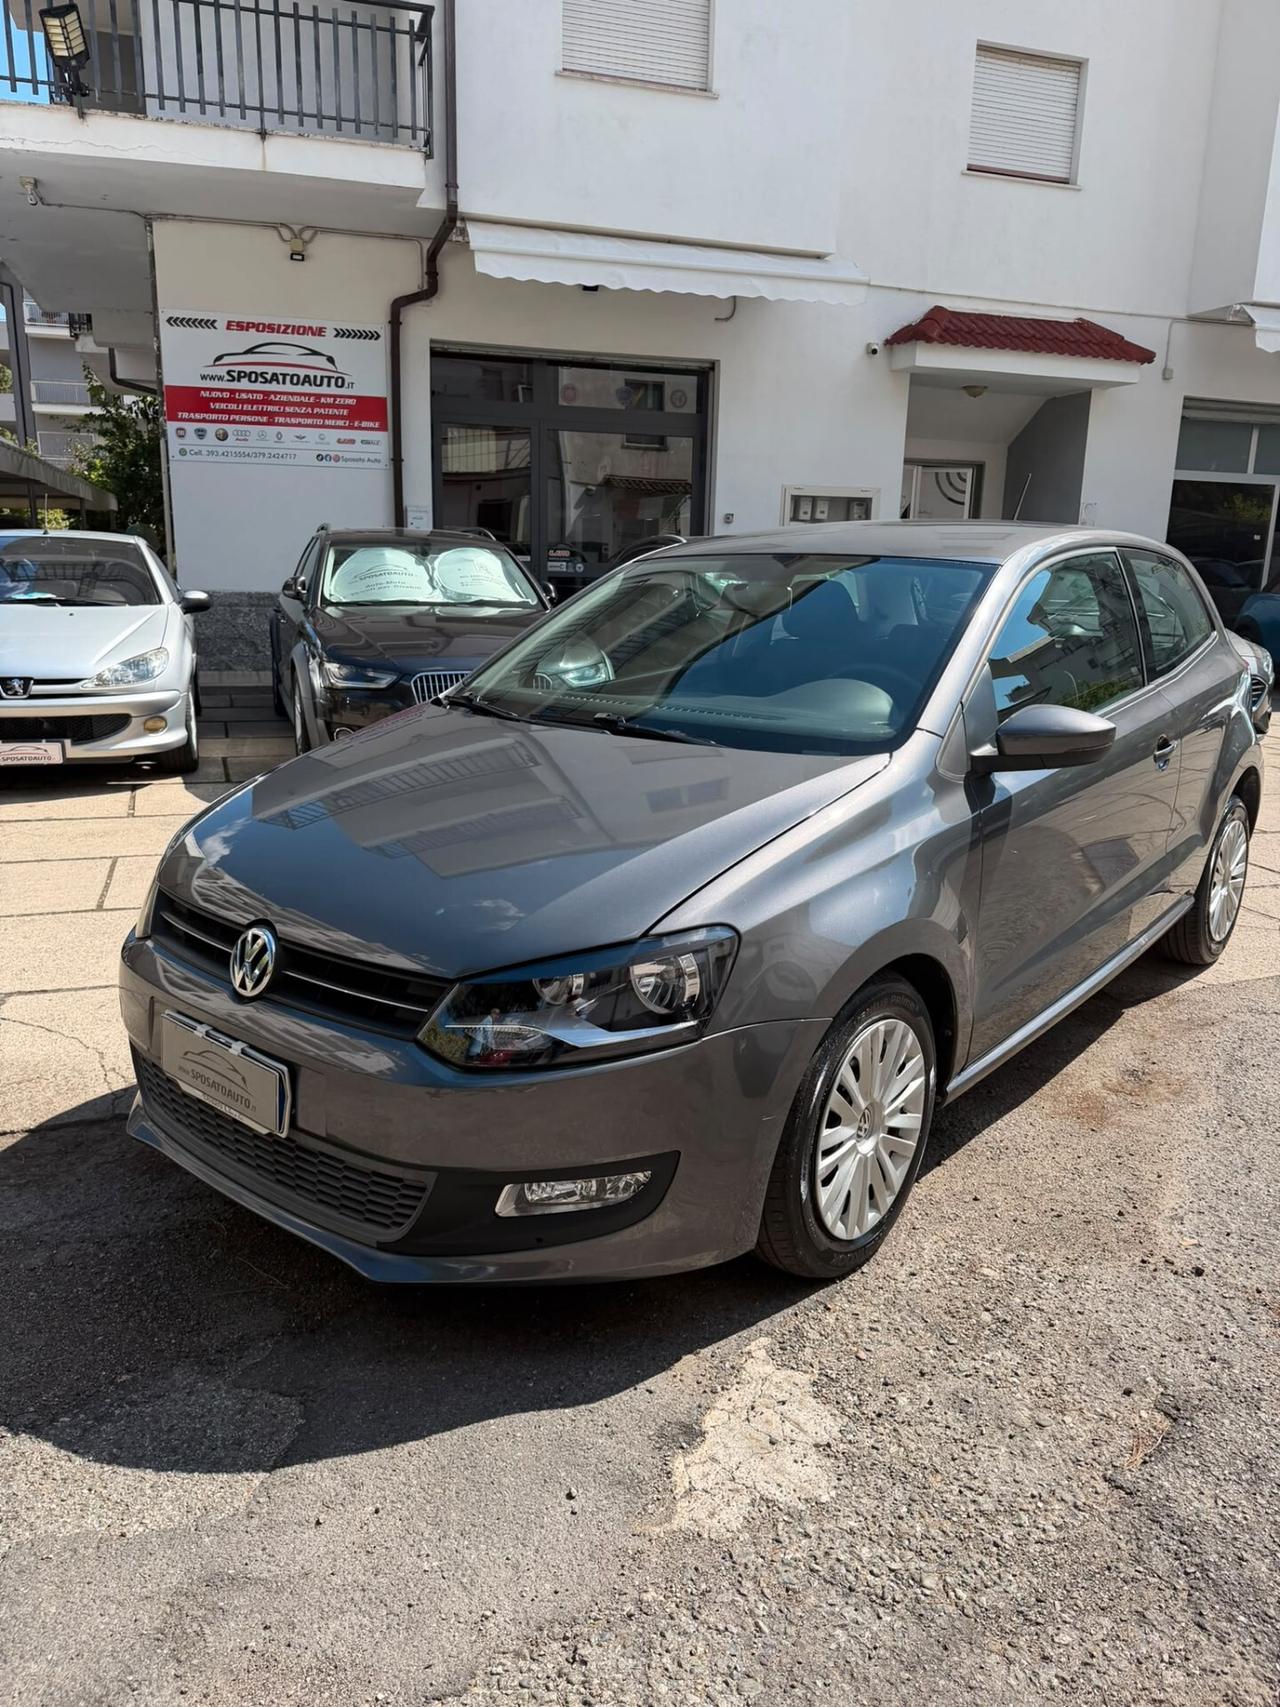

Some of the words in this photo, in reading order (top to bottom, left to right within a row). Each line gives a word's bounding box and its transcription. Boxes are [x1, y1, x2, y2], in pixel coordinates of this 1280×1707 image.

[226, 320, 326, 337] ESPOSIZIONE
[268, 394, 315, 403] AZIENDALE
[243, 404, 283, 412] ELETTRICI
[178, 412, 228, 420] TRASPORTO
[230, 414, 268, 422] PERSONE
[274, 416, 322, 425] TRASPORTO
